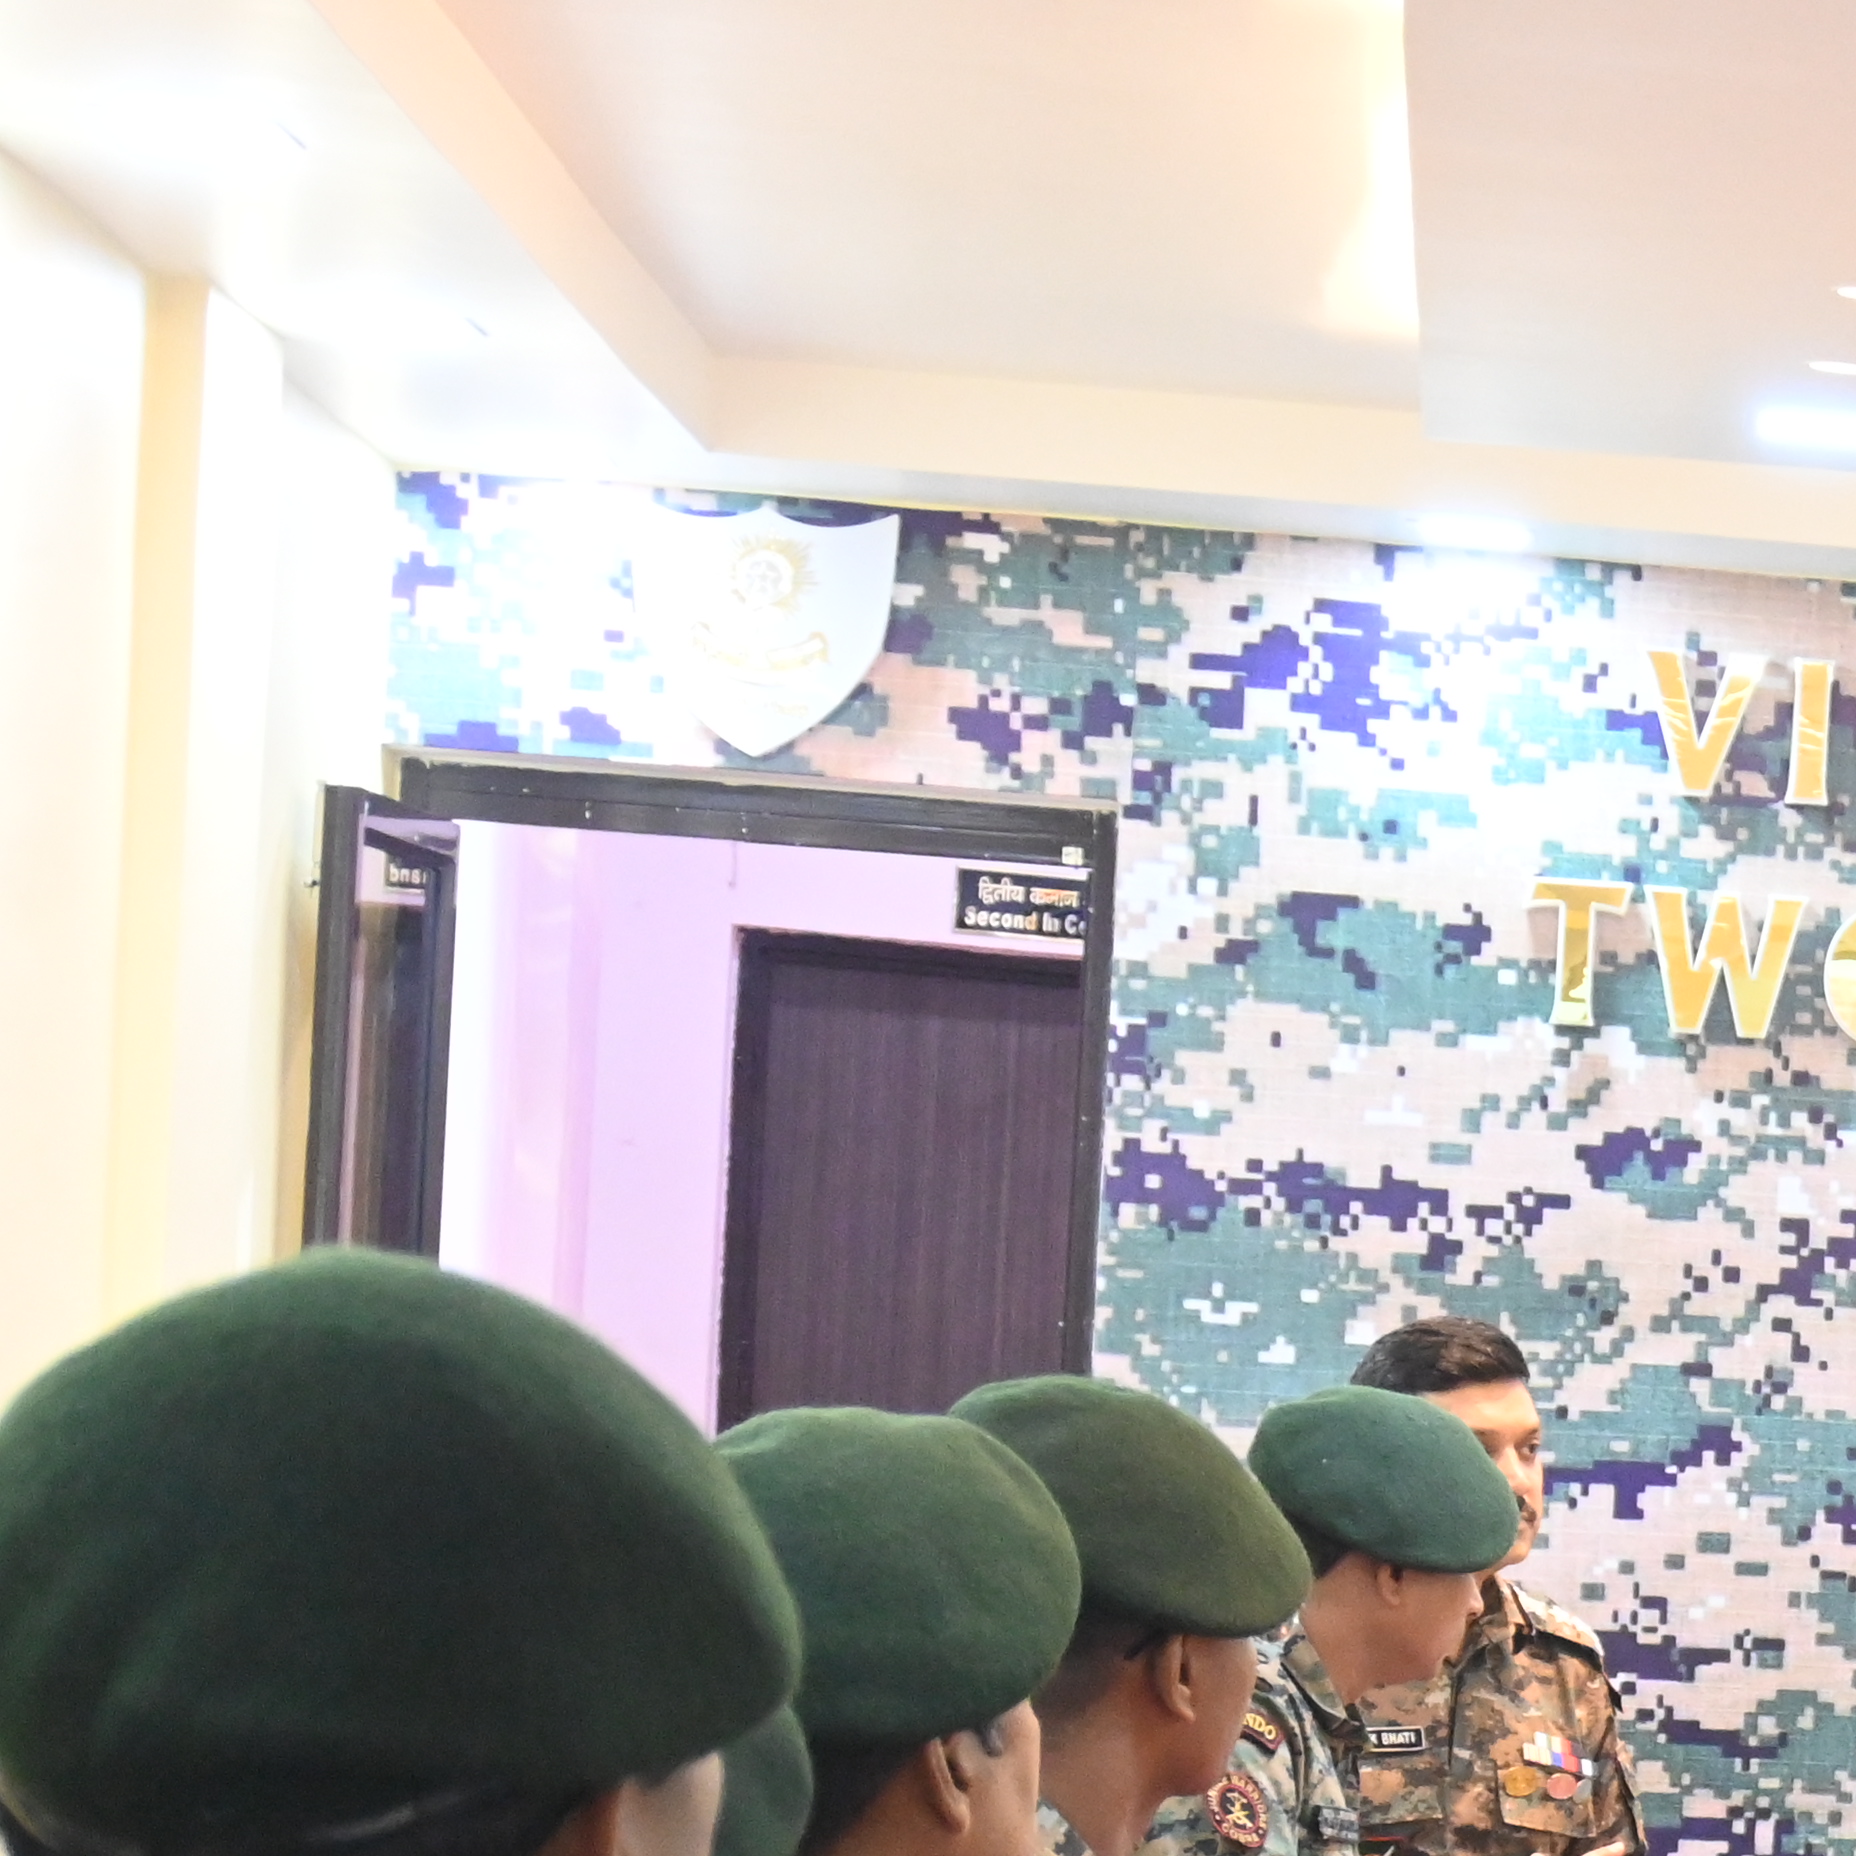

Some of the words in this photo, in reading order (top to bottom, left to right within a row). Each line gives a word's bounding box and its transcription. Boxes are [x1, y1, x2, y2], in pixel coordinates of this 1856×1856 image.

[964, 905, 1039, 931] Second
[1042, 912, 1061, 933] In
[1381, 1731, 1416, 1746] BHATI
